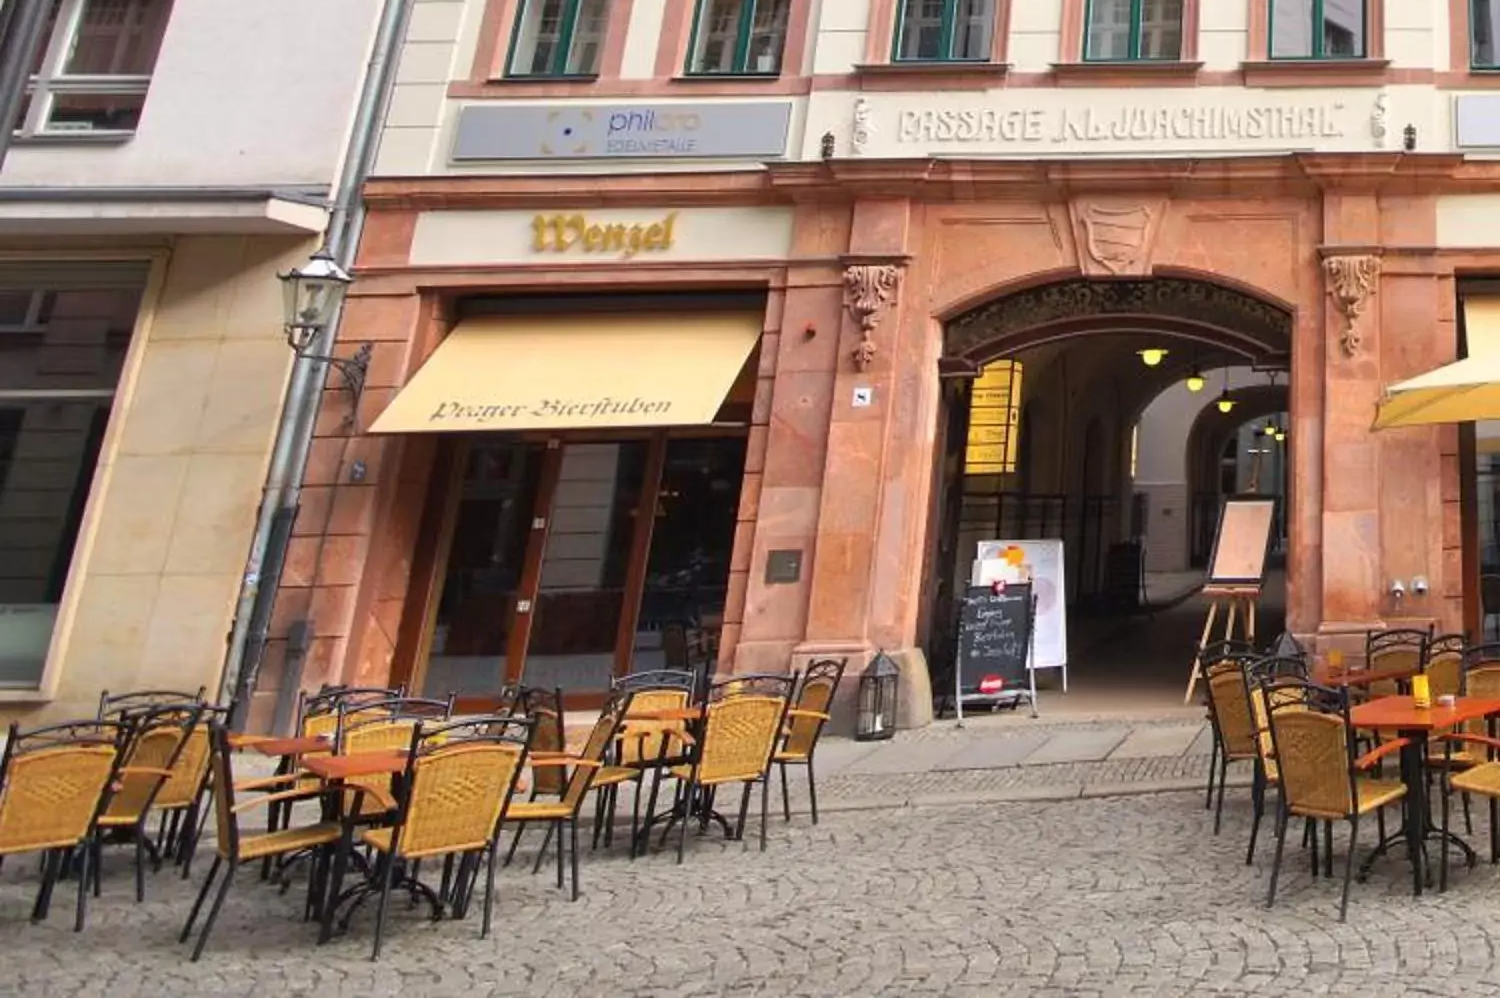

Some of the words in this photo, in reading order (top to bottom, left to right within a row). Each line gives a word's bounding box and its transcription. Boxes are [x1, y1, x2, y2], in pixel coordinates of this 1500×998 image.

[897, 107, 1047, 144] PASSAGE
[530, 210, 679, 259] Wenzel
[429, 401, 528, 423] Prager
